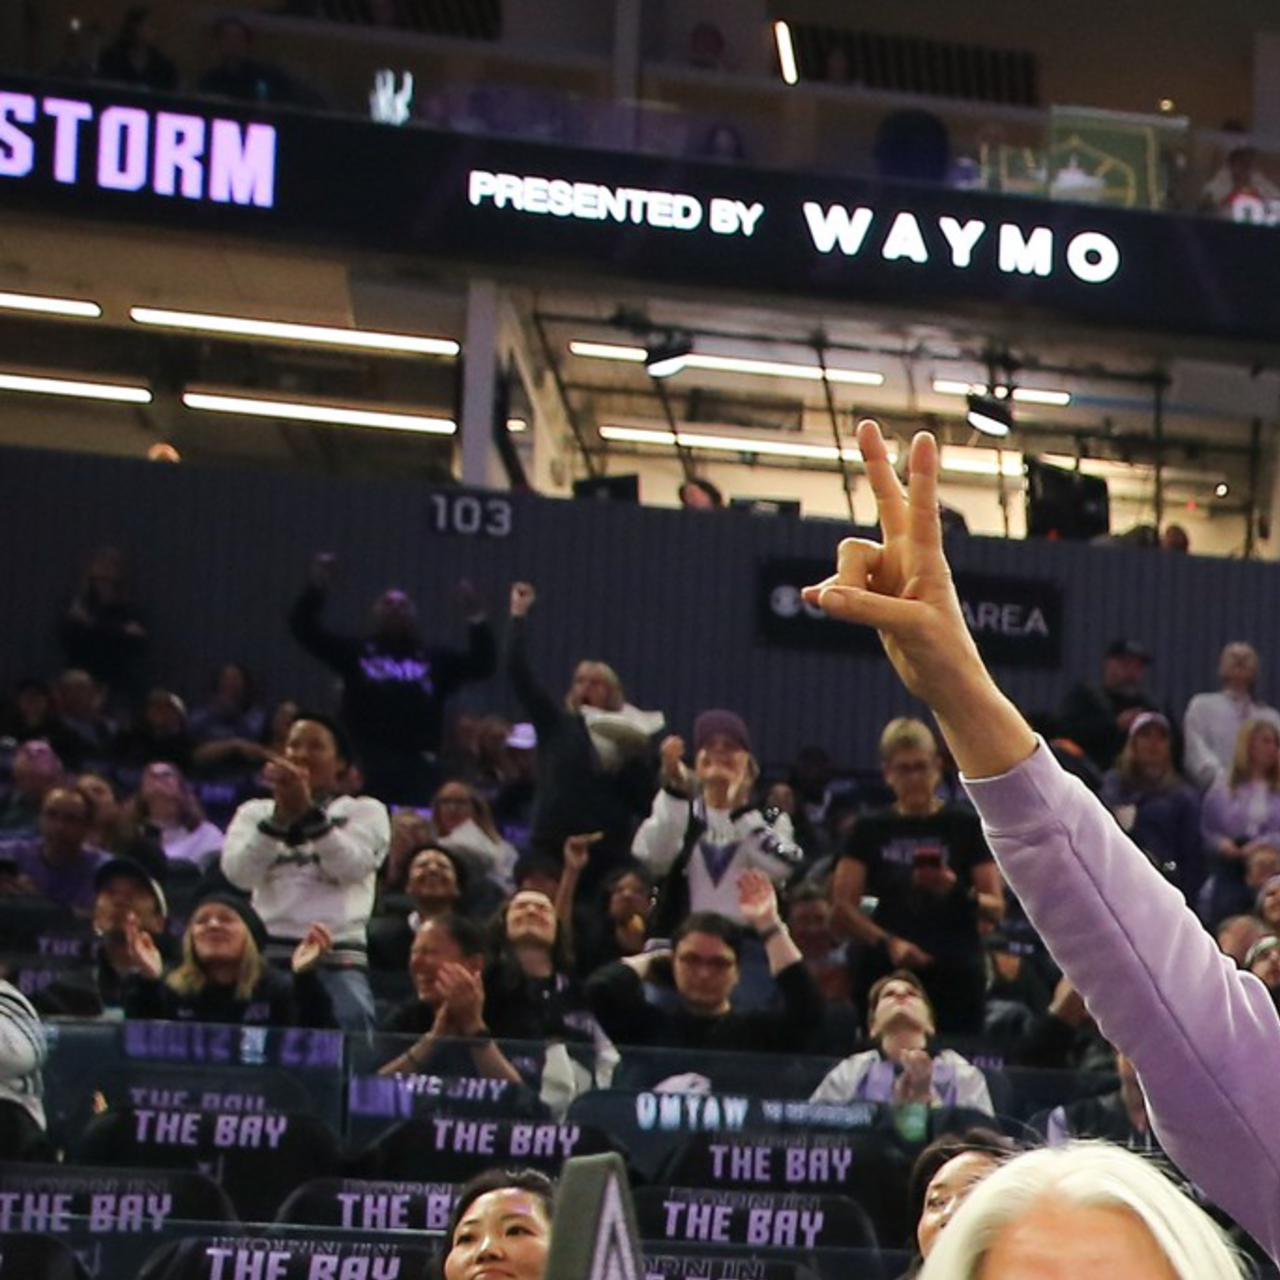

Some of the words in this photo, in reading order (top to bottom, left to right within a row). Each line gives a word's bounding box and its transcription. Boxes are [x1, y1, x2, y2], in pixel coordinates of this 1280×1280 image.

[0, 91, 276, 209] STORM
[468, 169, 702, 232] PRESENTED
[710, 197, 764, 236] BY
[804, 202, 1120, 284] WAYMO
[430, 493, 513, 538] 103
[134, 1109, 202, 1145] THE
[214, 1114, 288, 1148] BAY
[433, 1118, 498, 1154] THE
[510, 1123, 581, 1156] BAY
[709, 1145, 771, 1180] THE
[786, 1147, 852, 1182] BAY
[0, 1192, 73, 1232] THE
[90, 1194, 173, 1232] BAY
[337, 1193, 411, 1229] THE
[664, 1202, 732, 1241] THE
[747, 1208, 825, 1248] BAY
